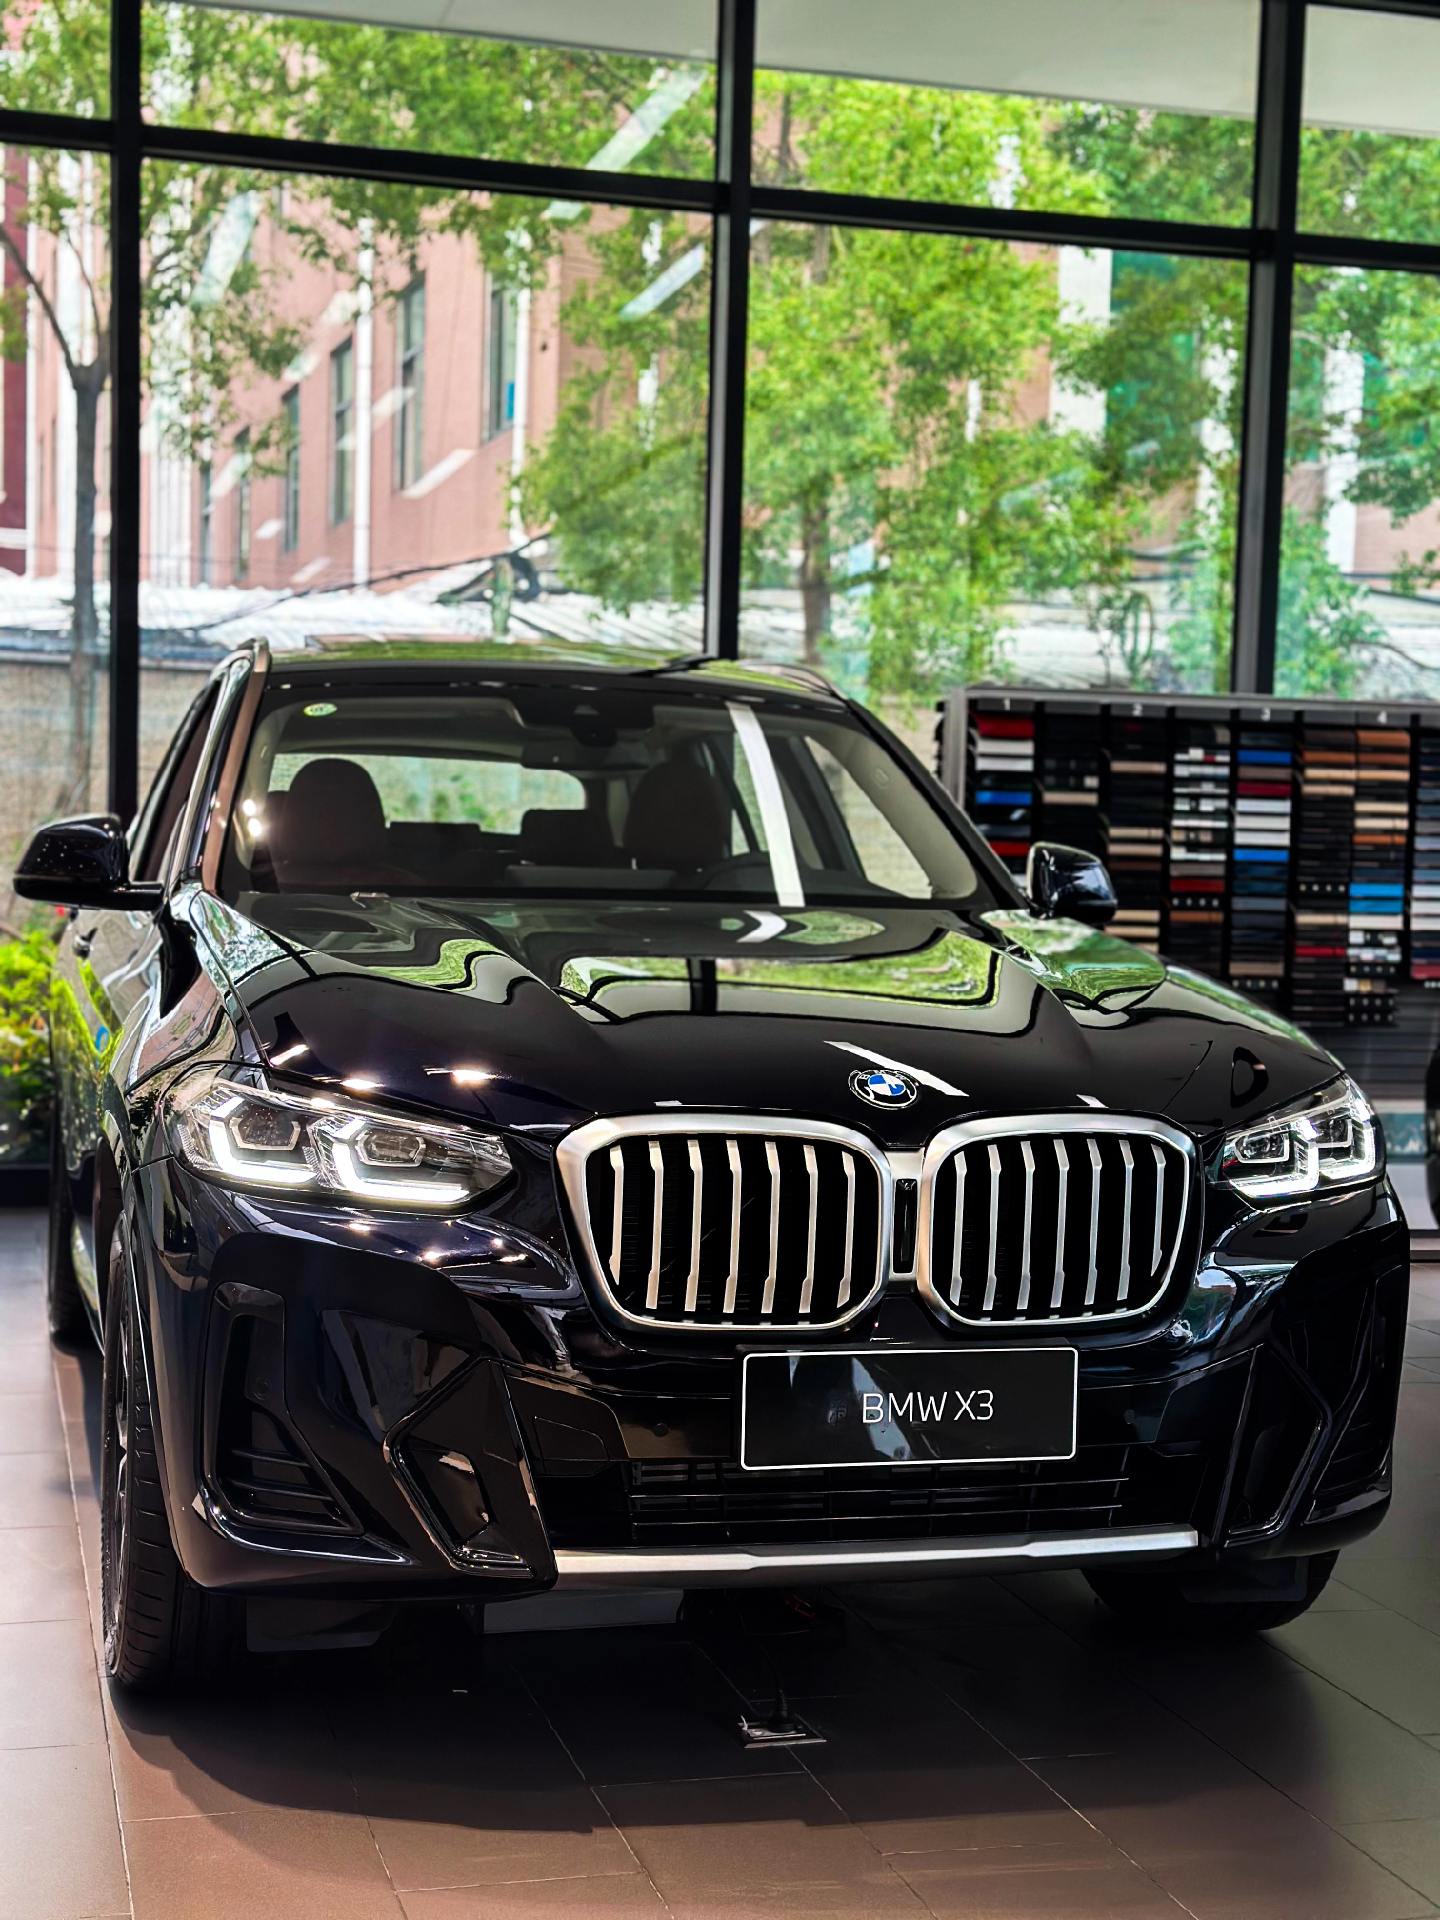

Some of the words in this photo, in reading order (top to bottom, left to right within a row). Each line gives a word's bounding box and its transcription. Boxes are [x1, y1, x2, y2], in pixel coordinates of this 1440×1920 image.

[1132, 702, 1144, 716] 2
[1260, 706, 1272, 720] 3
[1376, 711, 1387, 724] 4
[863, 1391, 948, 1423] BMW
[954, 1389, 994, 1421] X3
